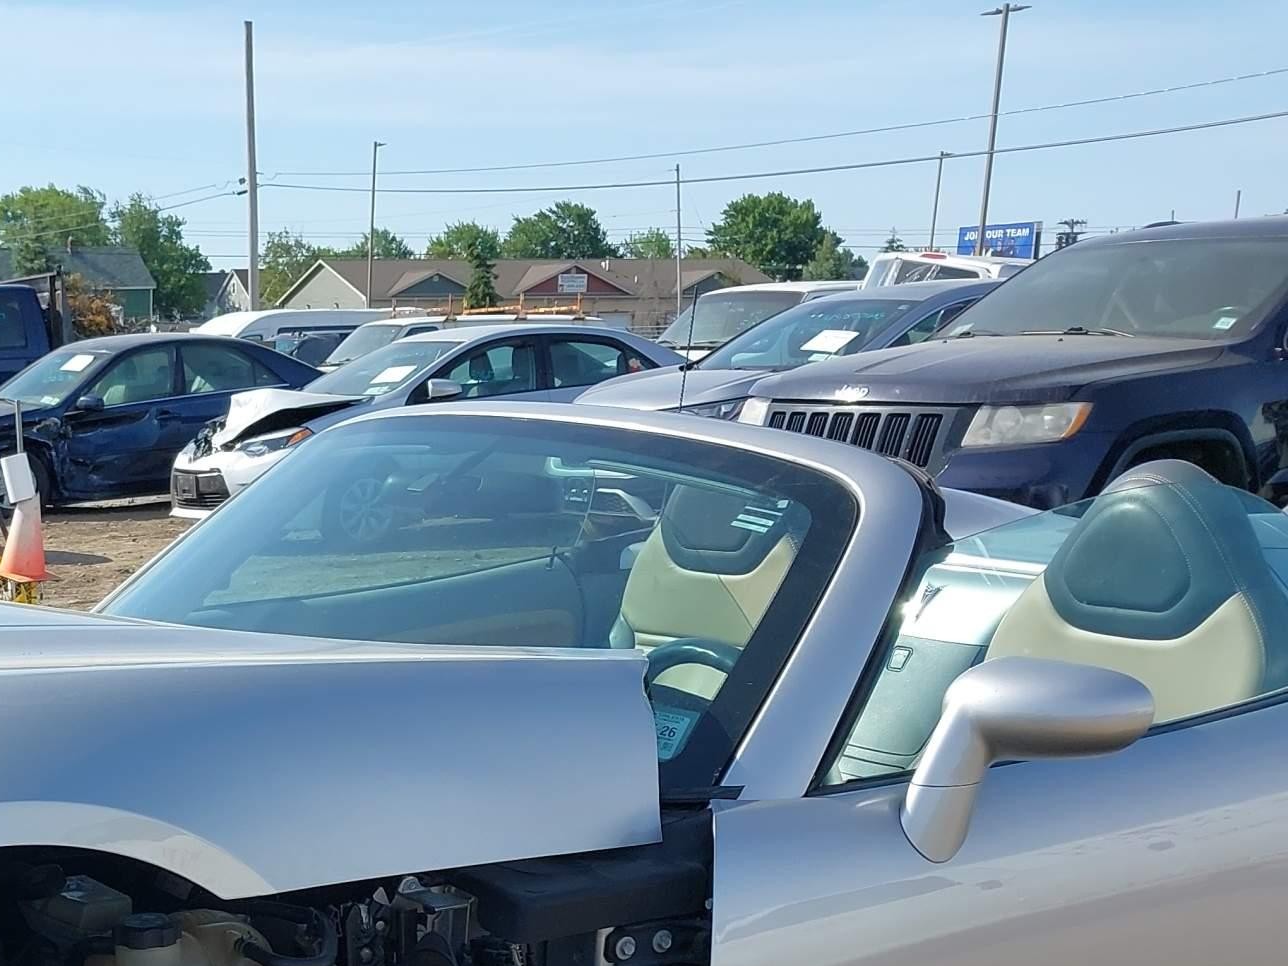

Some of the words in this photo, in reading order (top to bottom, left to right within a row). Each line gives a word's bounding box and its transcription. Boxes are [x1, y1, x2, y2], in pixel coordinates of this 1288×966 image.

[985, 229, 1004, 239] OUR
[1006, 227, 1030, 238] TEAM
[659, 725, 678, 738] 26
